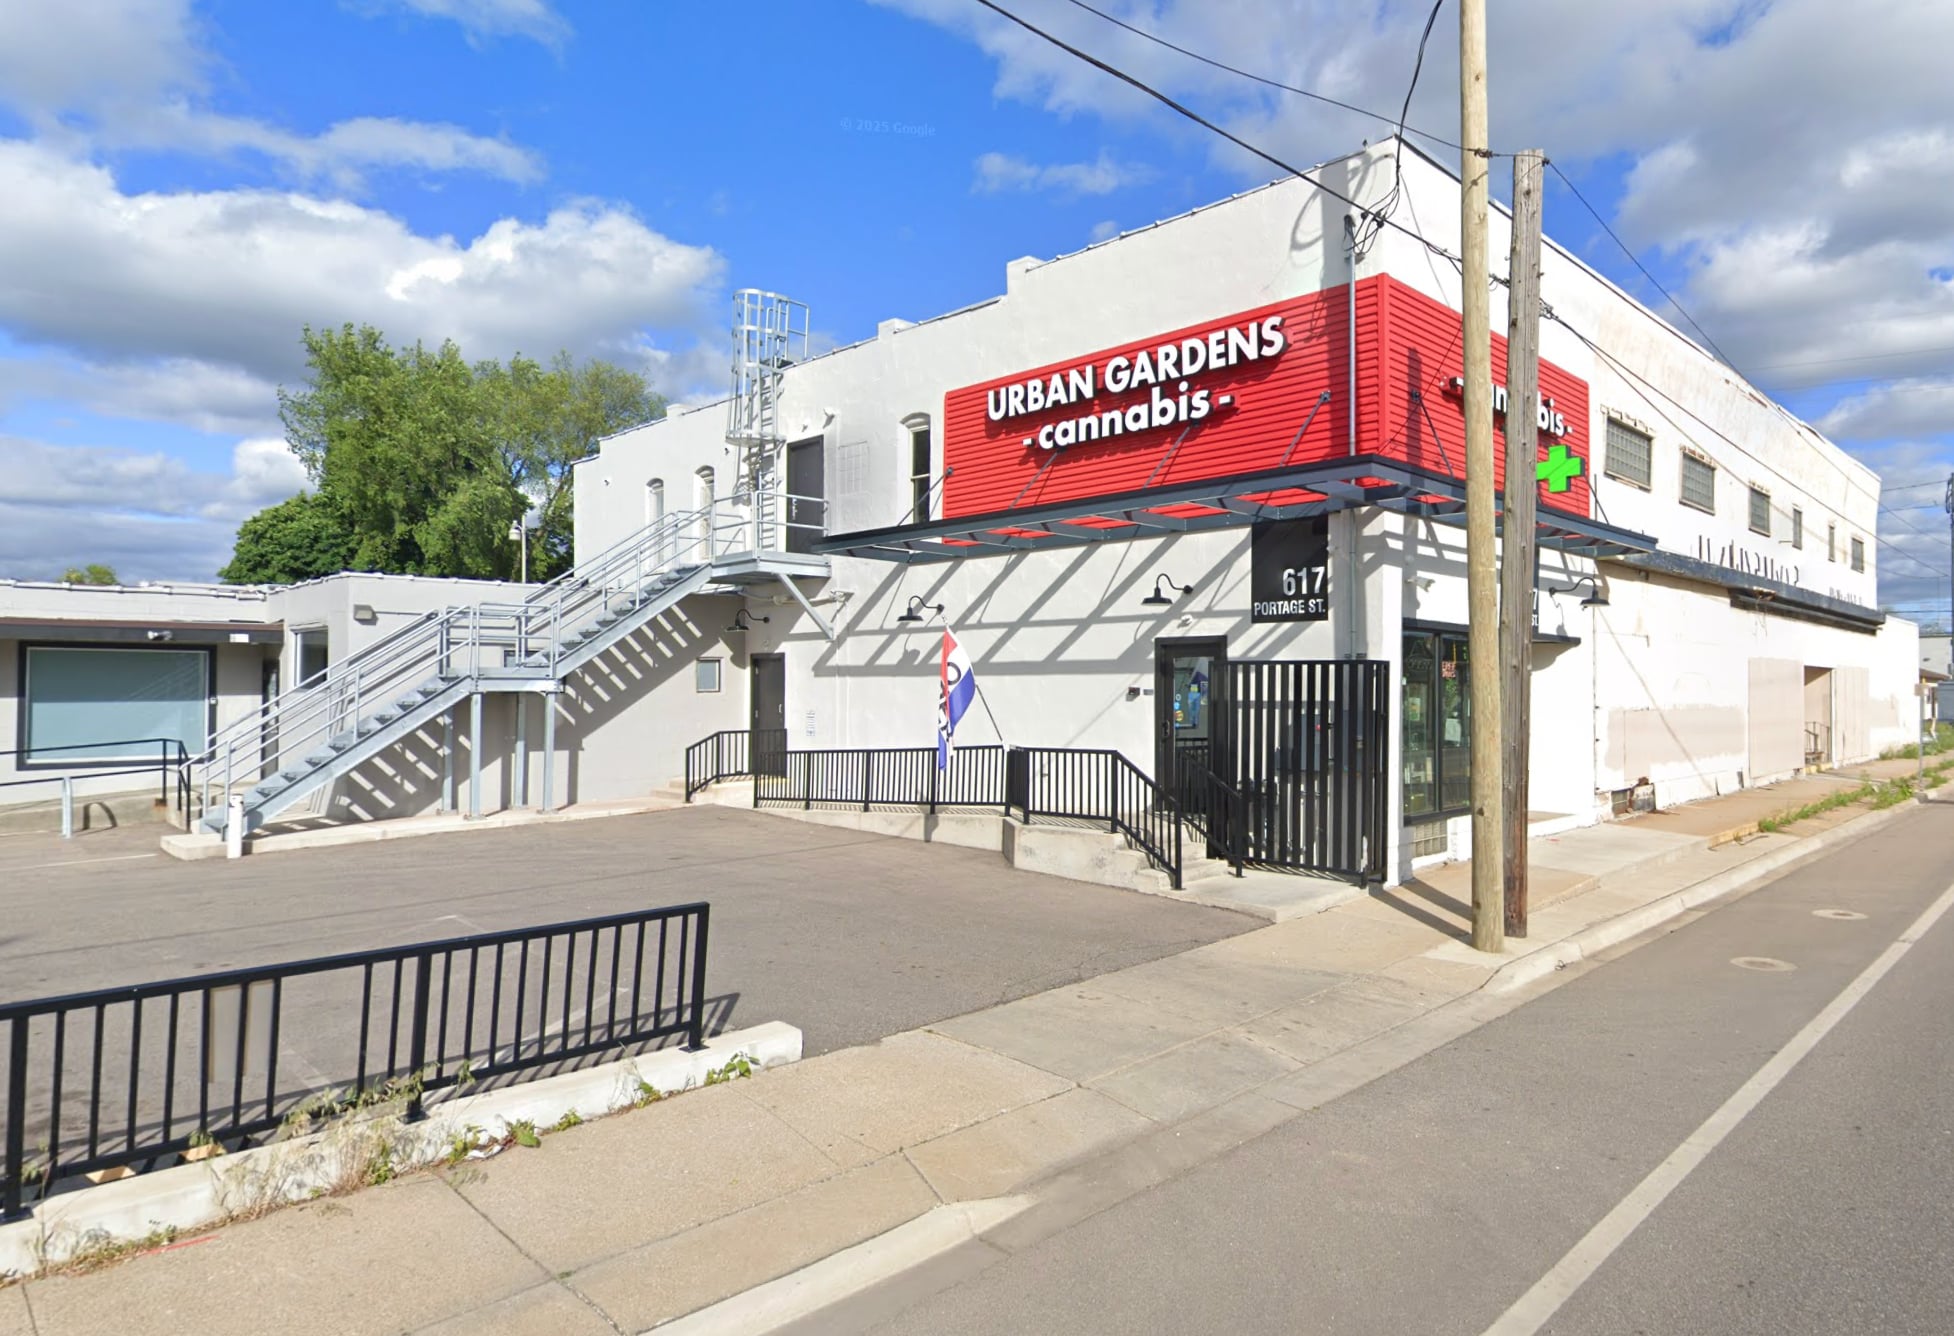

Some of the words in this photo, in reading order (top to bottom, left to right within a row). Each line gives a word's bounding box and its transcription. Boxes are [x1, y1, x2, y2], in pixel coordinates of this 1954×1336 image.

[987, 365, 1096, 421] URBAN
[1104, 316, 1286, 393] GARDENS
[1038, 381, 1210, 449] cannabis
[1282, 566, 1325, 596] 617
[1254, 600, 1305, 616] PORTAGE
[1308, 599, 1326, 614] ST.
